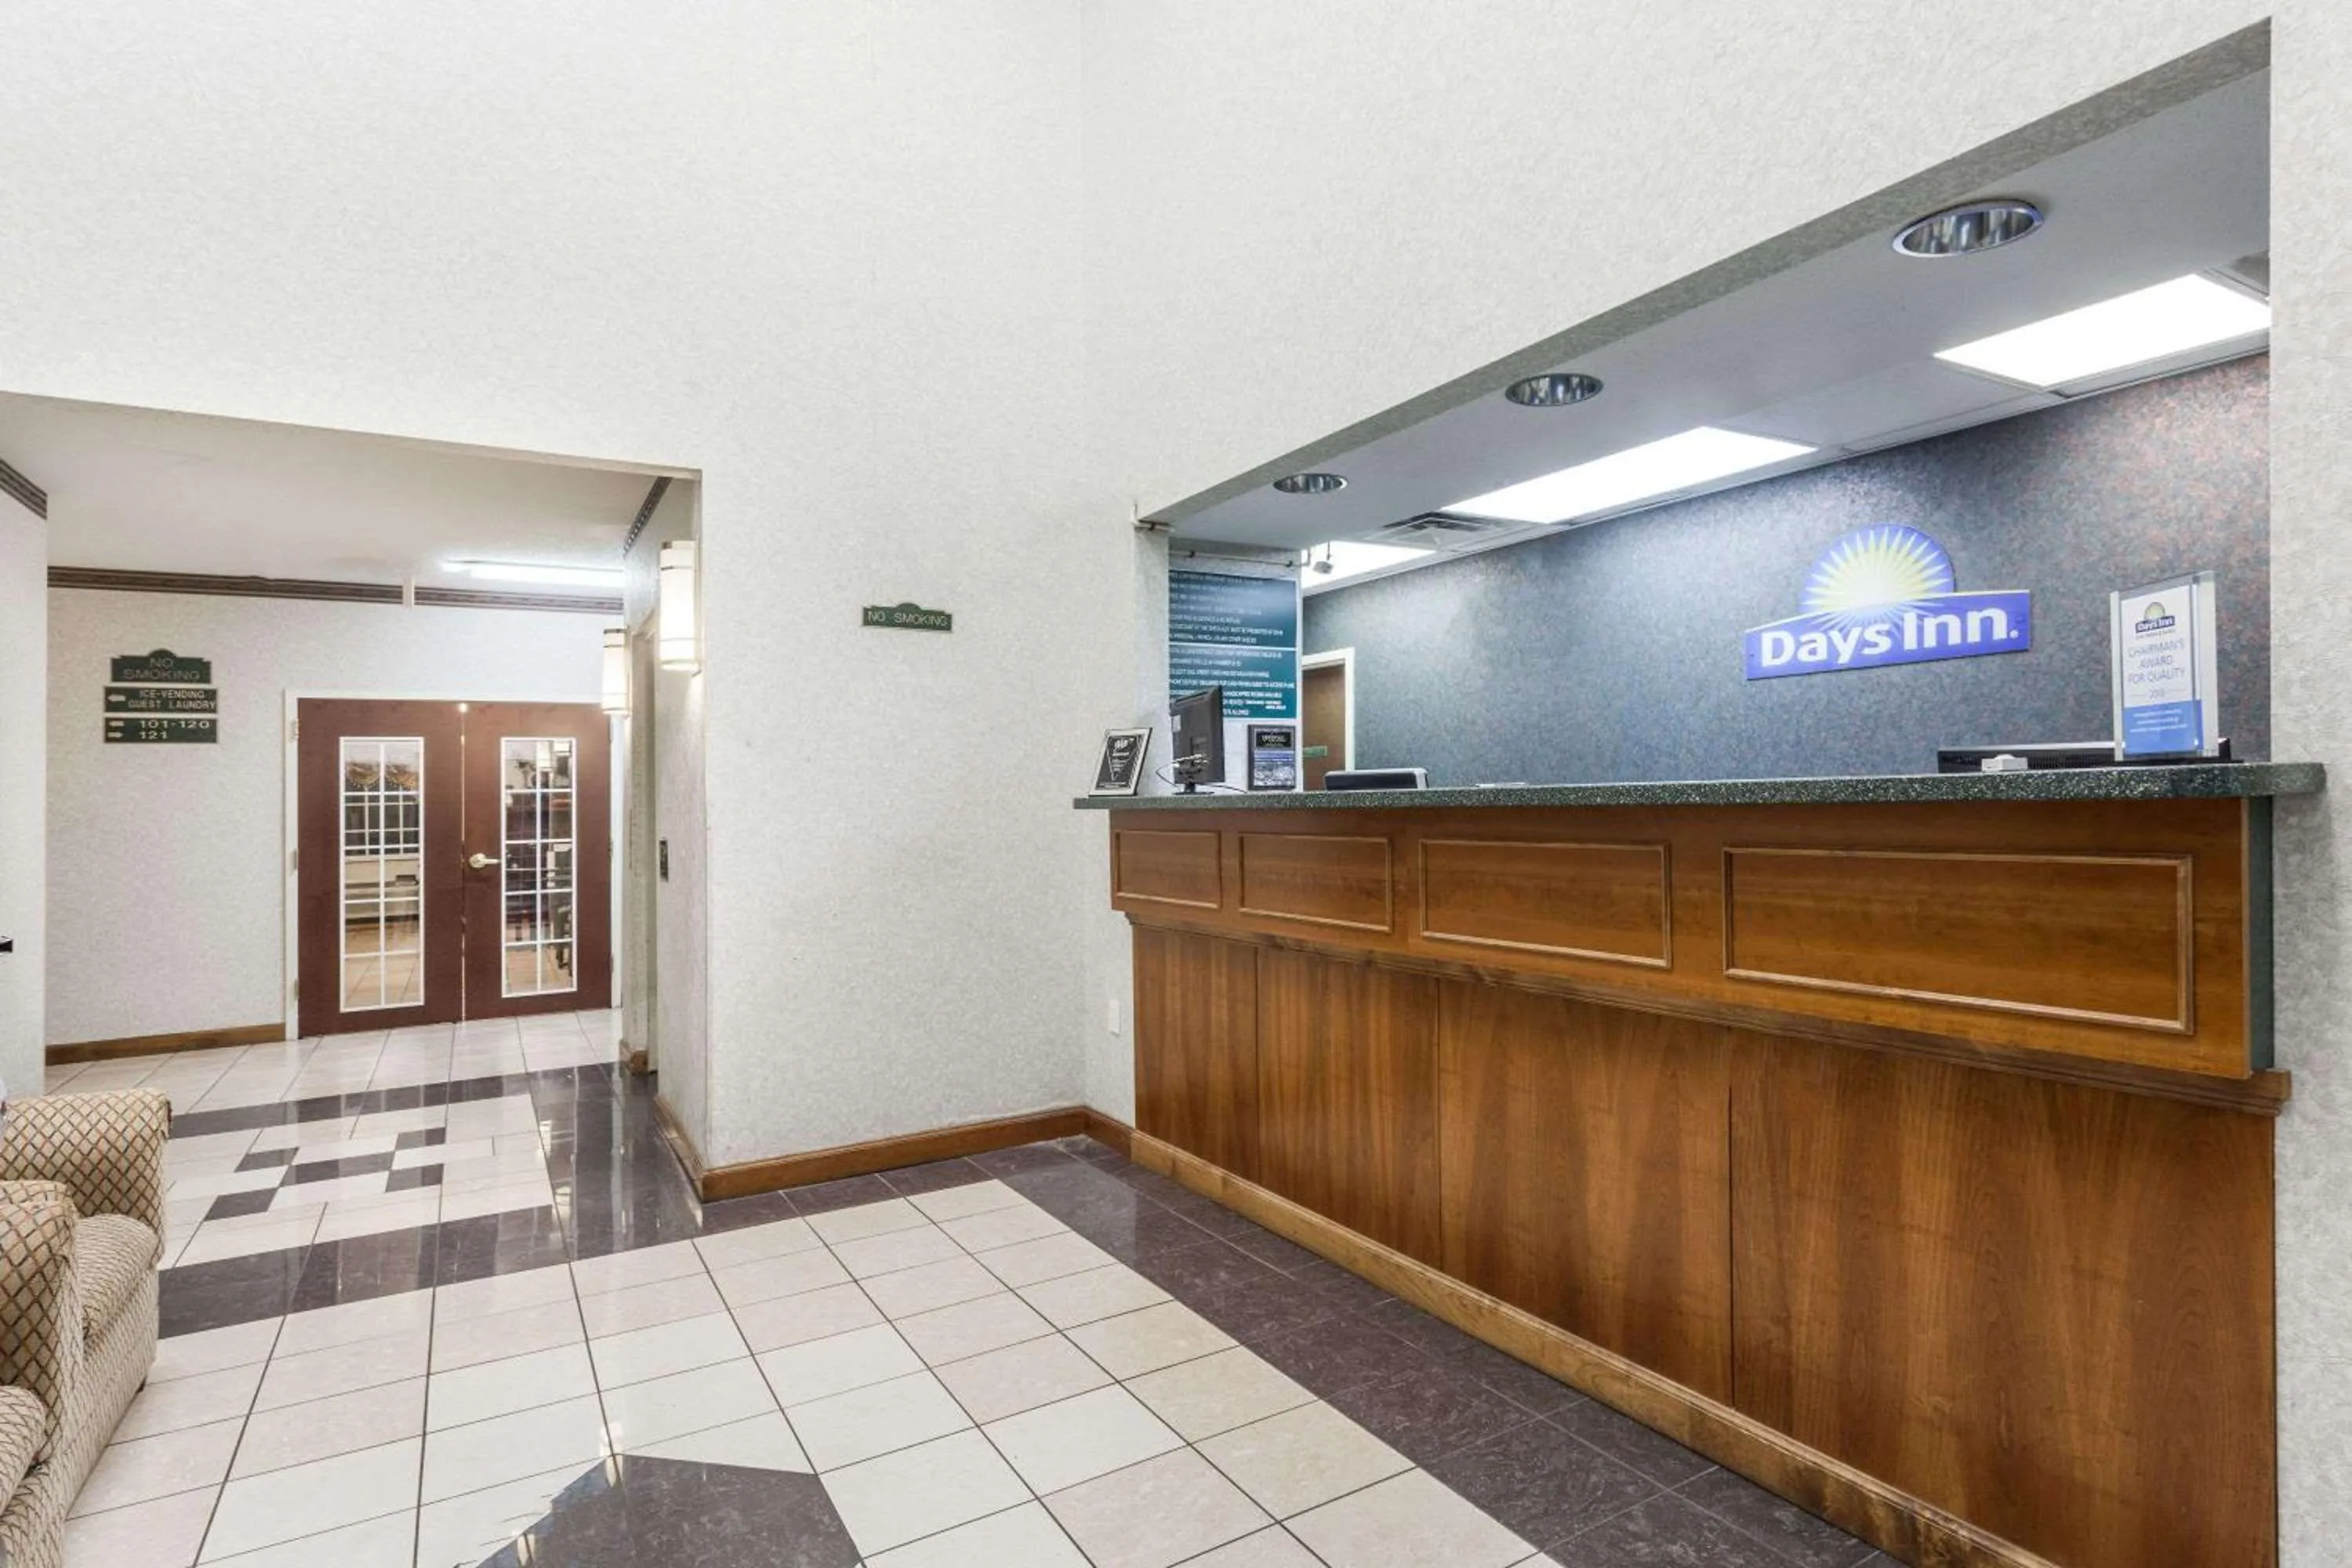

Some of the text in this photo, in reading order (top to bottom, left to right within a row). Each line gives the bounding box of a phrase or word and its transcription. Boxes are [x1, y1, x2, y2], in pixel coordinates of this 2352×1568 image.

[867, 611, 948, 626] NO SMOKING
[1761, 607, 2020, 665] Days Inn.
[150, 657, 174, 667] NO
[2140, 654, 2174, 669] AWARD
[123, 668, 201, 680] SMOKING
[2128, 666, 2186, 685] FOR QUALITY
[139, 689, 205, 699] ICE-VENDING
[128, 699, 216, 710] GUEST LAUNDRY
[139, 720, 210, 729] 101-120
[139, 731, 169, 740] 121
